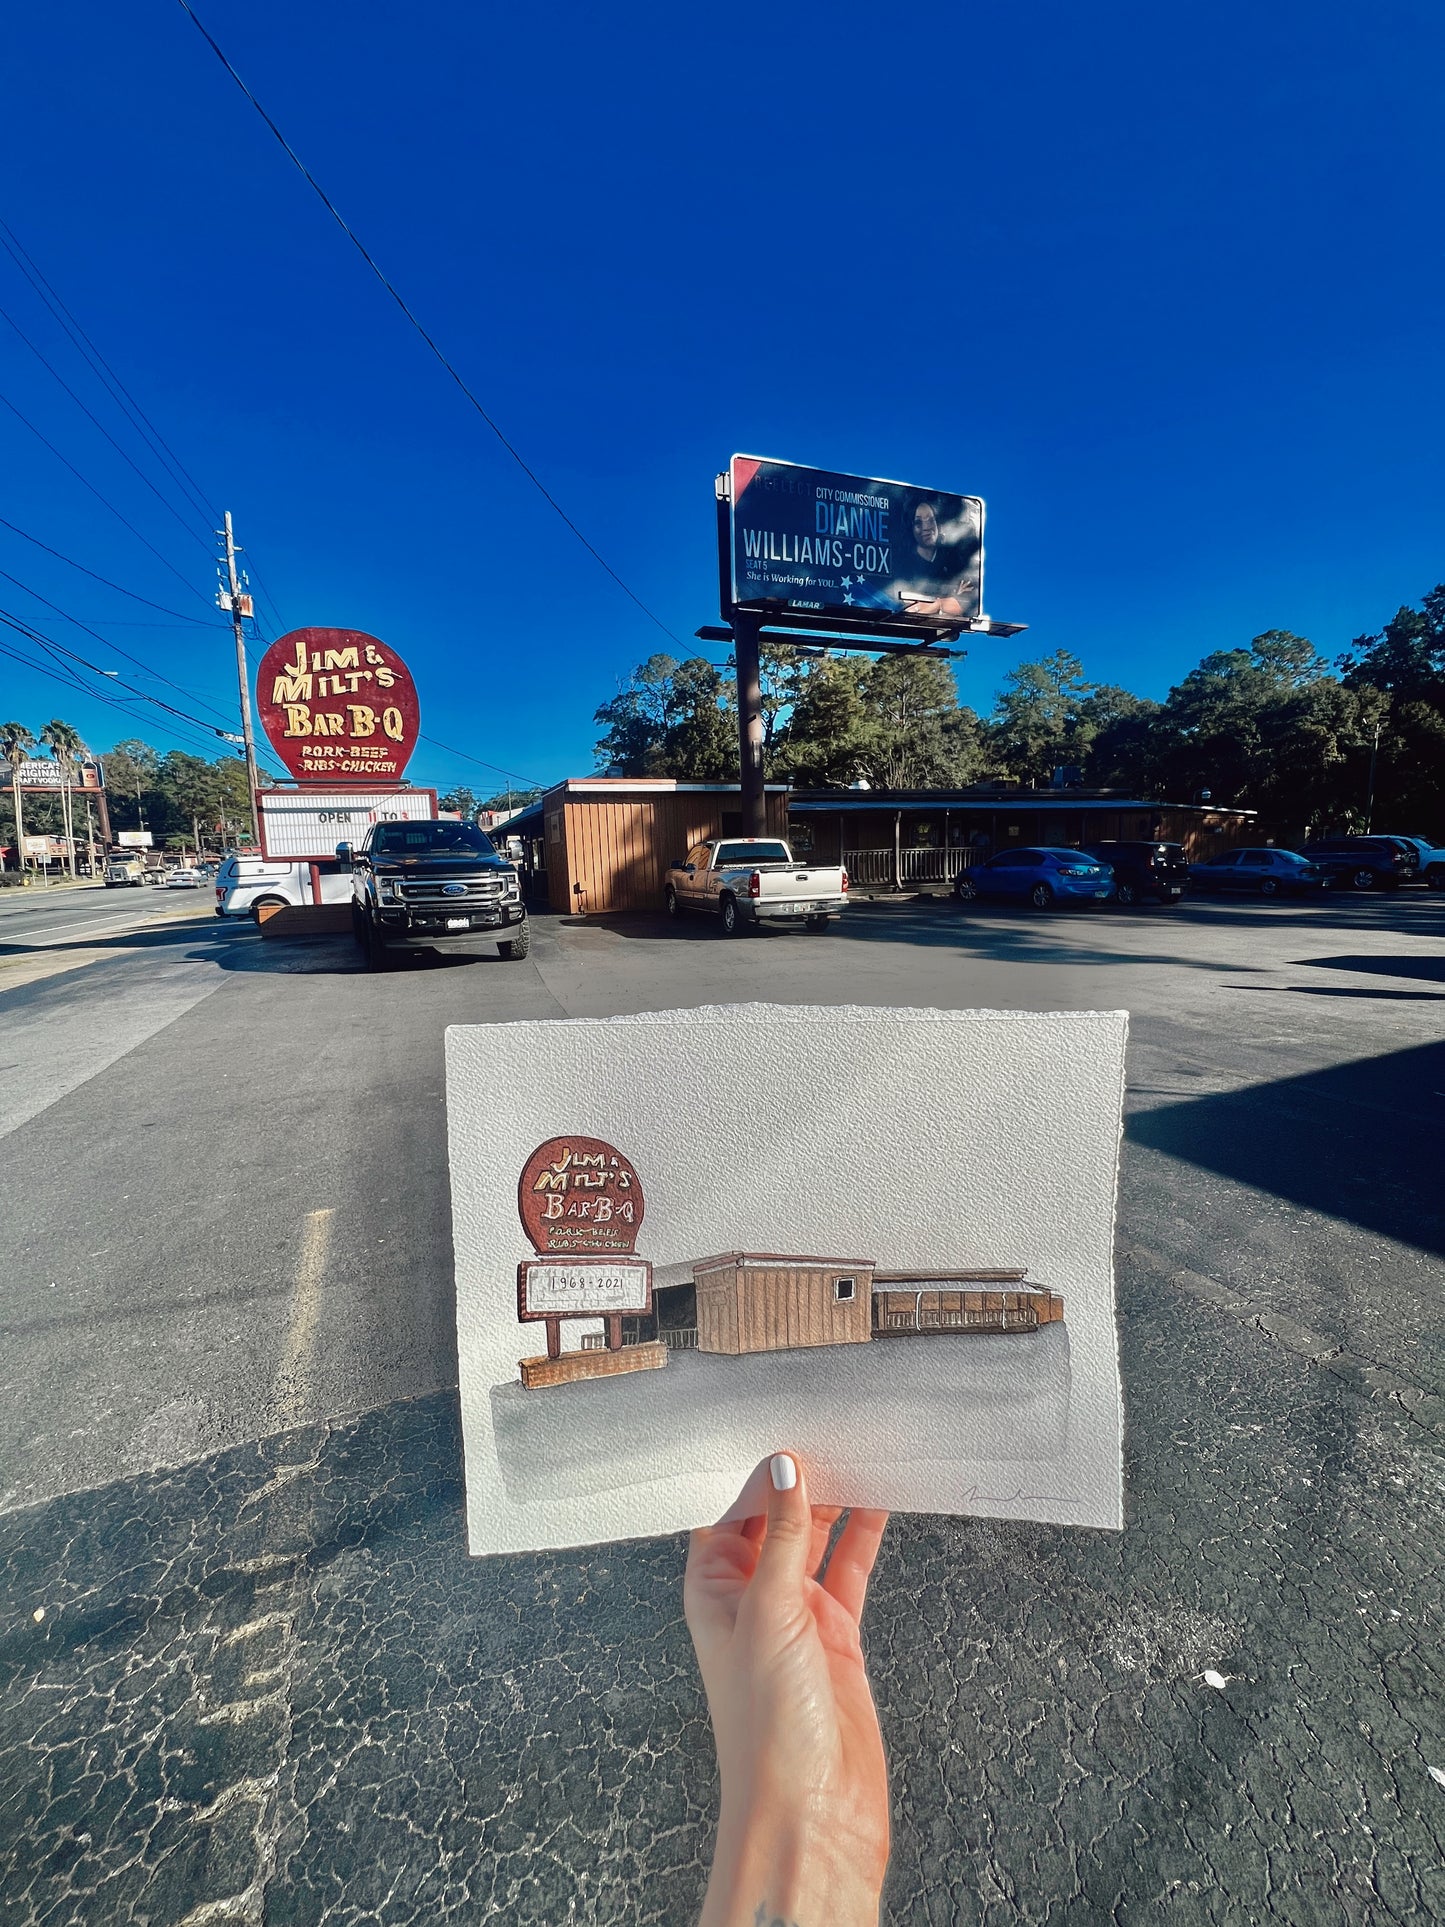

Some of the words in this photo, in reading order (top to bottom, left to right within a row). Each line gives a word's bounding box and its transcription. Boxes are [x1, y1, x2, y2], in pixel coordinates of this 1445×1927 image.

[816, 487, 833, 500] CITY
[835, 490, 889, 510] COMMISSIONER
[815, 501, 890, 543] DIANNE
[743, 528, 889, 574] WILLIAMS-COX
[746, 559, 762, 570] SEAT
[763, 561, 768, 571] 5
[746, 571, 762, 581] She
[771, 573, 804, 586] Working
[805, 576, 817, 588] for
[792, 599, 820, 609] LAMAR
[284, 642, 359, 678] JIM
[366, 645, 384, 665] &
[272, 668, 396, 704] MILT'S
[282, 703, 345, 737] BAR
[319, 813, 351, 823] OPEN
[368, 812, 376, 822] 11
[382, 812, 398, 820] TO
[550, 1147, 606, 1172] JIM
[533, 1171, 632, 1190] MILT'S
[541, 1193, 590, 1219] BAR
